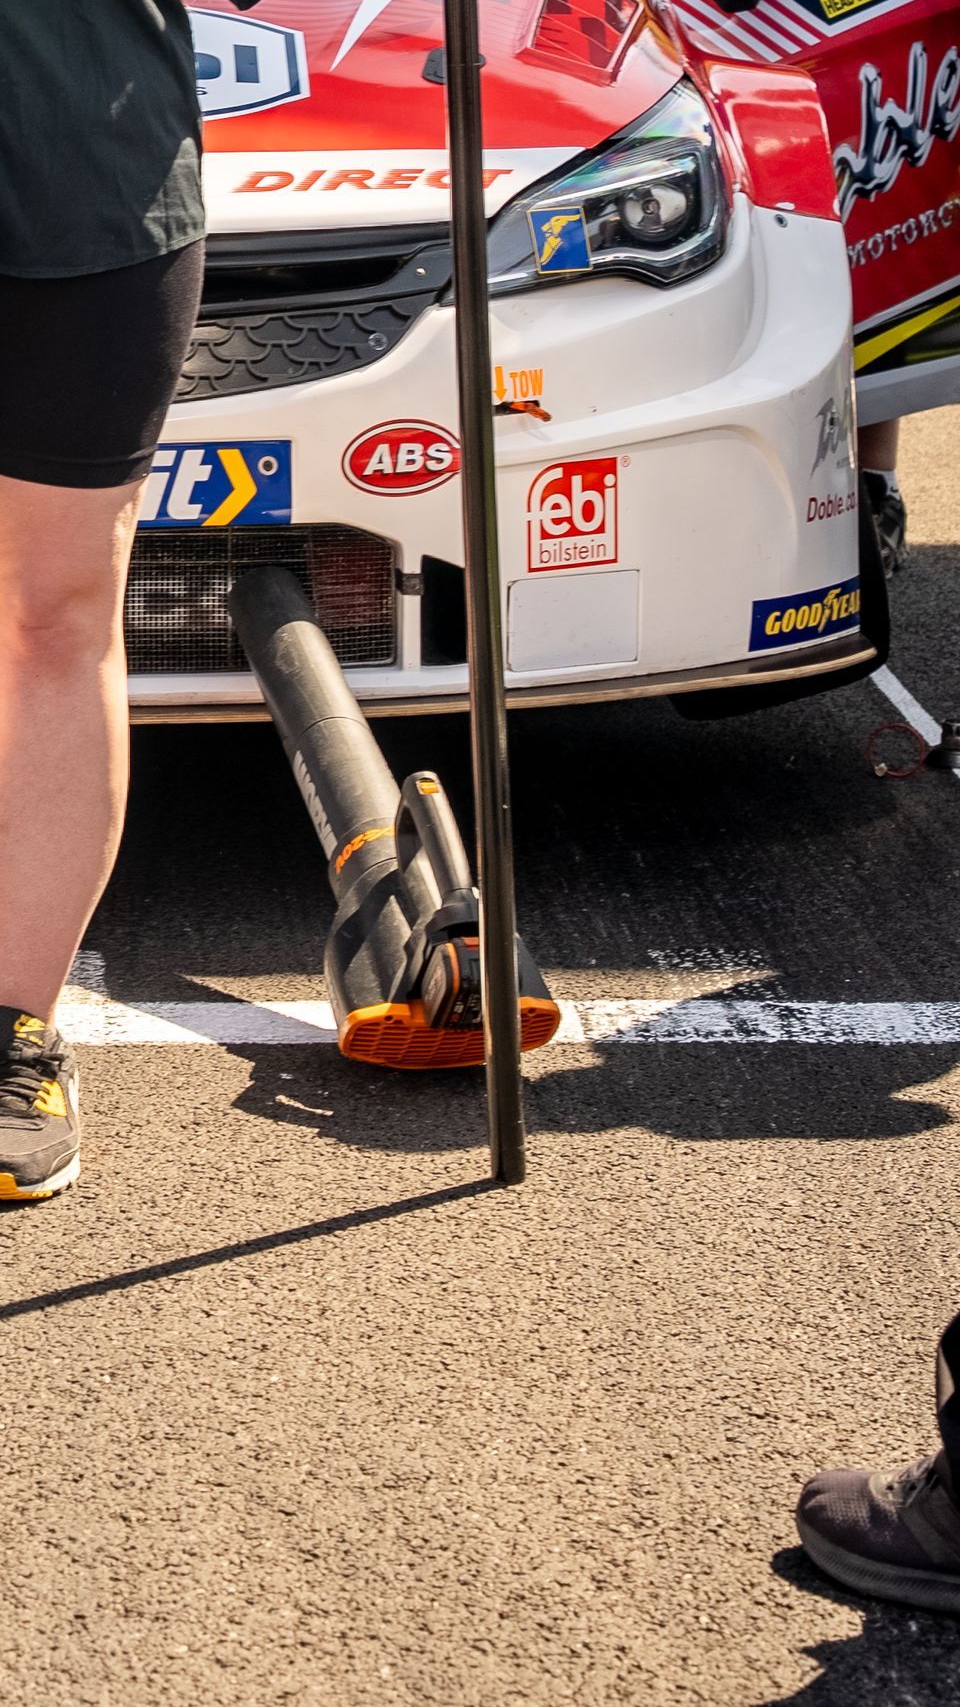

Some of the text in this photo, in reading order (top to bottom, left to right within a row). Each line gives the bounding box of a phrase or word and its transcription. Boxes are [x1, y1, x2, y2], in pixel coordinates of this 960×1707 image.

[510, 368, 544, 399] TOW
[362, 442, 453, 476] ABS
[525, 467, 617, 536] febi
[540, 539, 607, 564] bilstein
